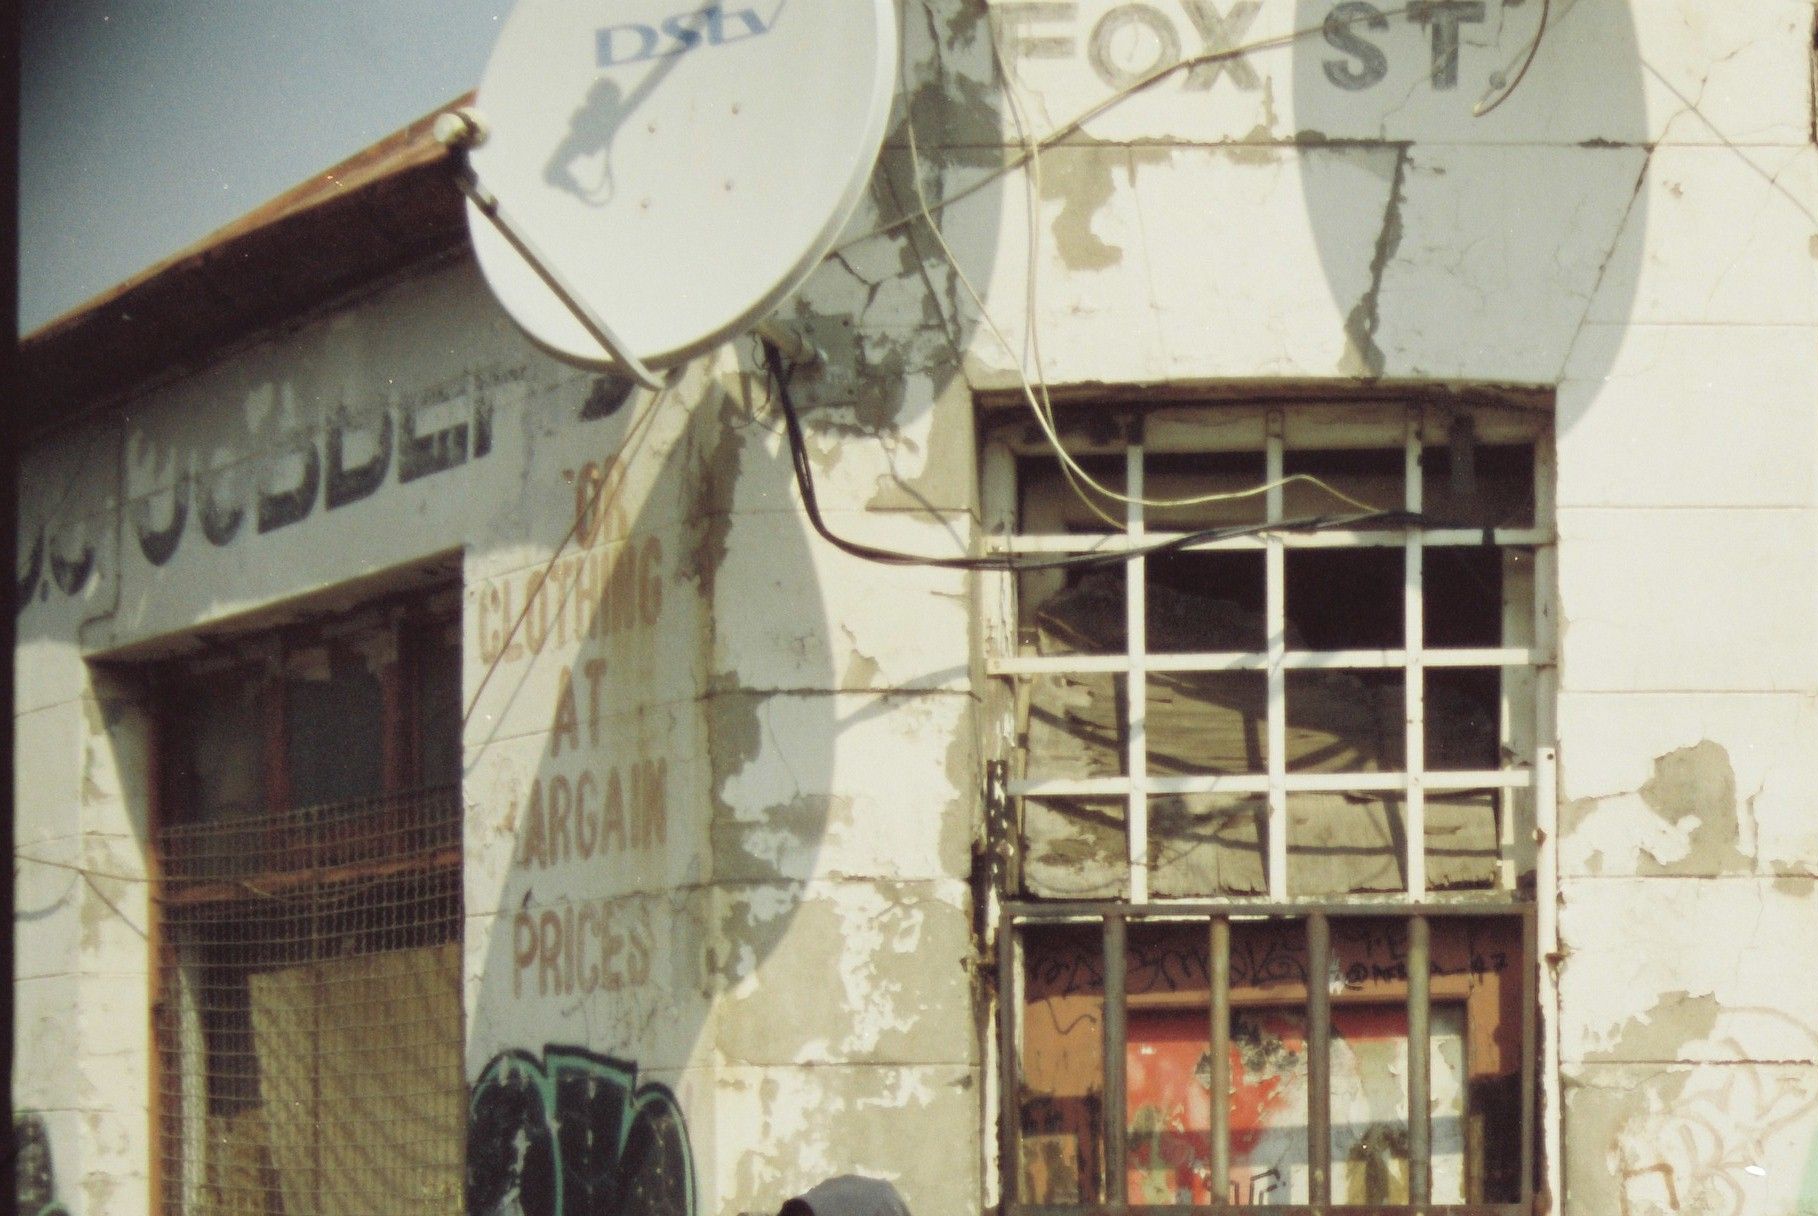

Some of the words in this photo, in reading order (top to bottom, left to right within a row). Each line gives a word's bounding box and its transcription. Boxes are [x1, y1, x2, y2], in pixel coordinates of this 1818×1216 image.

[1003, 0, 1261, 92] FOX
[479, 536, 664, 665] CLOTHING
[551, 658, 607, 758] AT
[513, 900, 658, 998] PRICES
